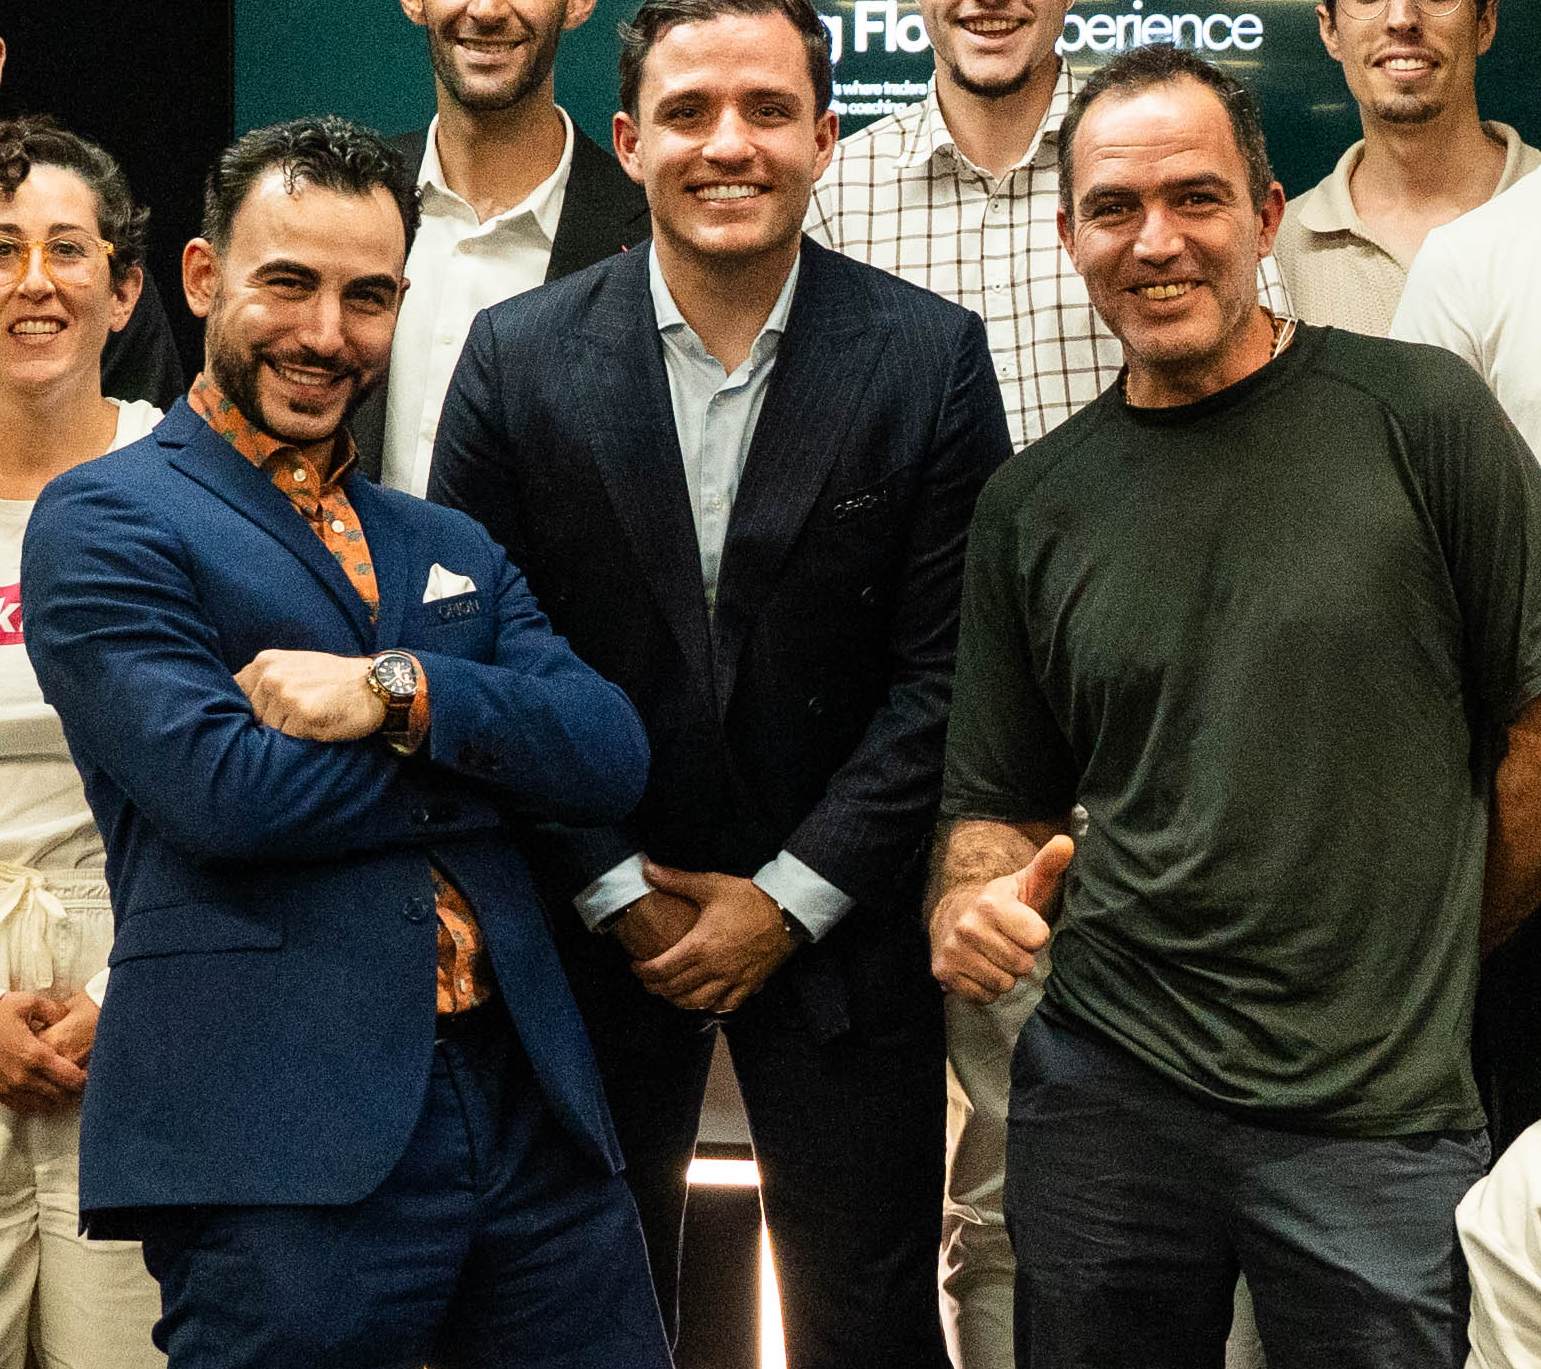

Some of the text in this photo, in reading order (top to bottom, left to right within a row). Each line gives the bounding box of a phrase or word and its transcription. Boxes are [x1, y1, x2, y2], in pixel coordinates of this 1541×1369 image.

[855, 0, 929, 53] Flo
[843, 80, 882, 95] where
[883, 80, 928, 95] traders
